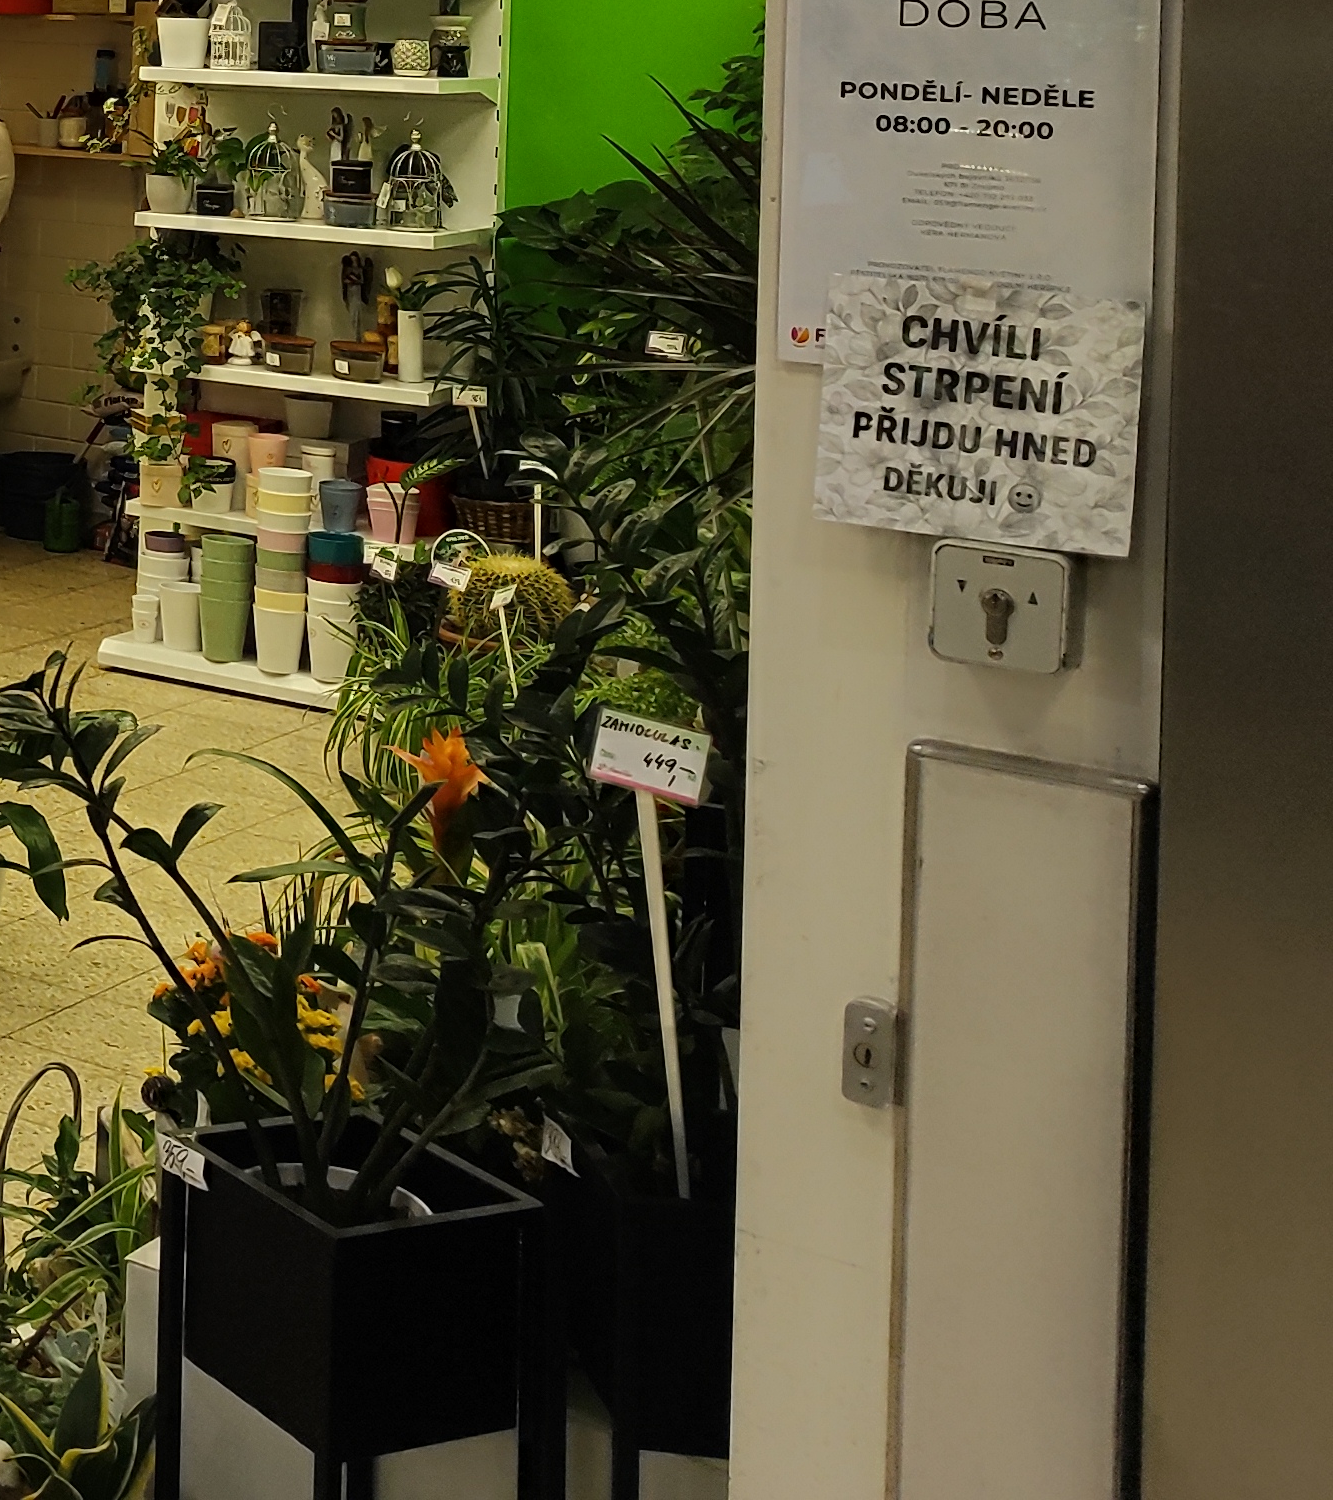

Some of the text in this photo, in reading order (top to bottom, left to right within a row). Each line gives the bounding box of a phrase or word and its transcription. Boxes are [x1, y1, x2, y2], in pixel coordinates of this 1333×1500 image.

[981, 84, 1096, 109] NEDĚLE
[875, 114, 952, 135] 08:00
[975, 118, 1055, 140] 20:00
[901, 314, 1042, 362] CHVÍLI
[881, 362, 1070, 415] STRPENÍ
[852, 406, 1098, 468] PŘIJDU HNED
[883, 462, 998, 506] DĚKUJI
